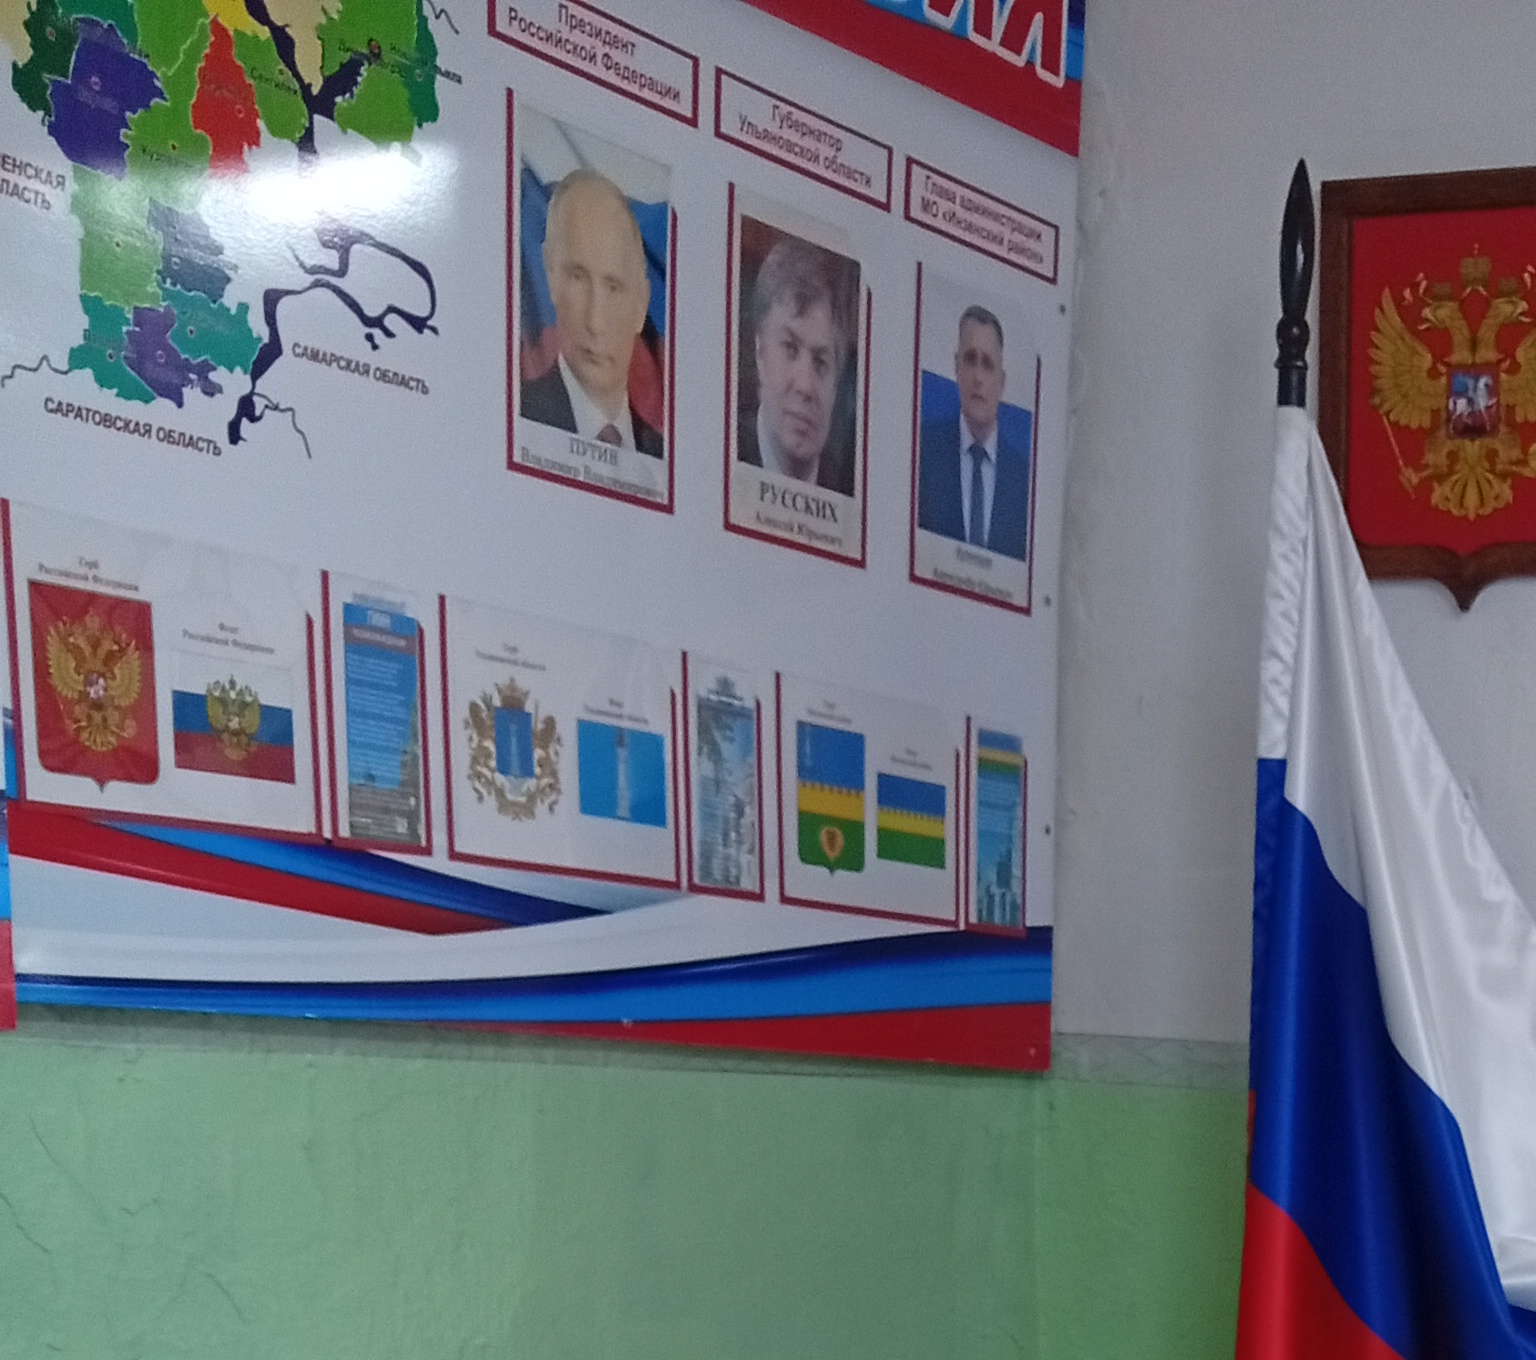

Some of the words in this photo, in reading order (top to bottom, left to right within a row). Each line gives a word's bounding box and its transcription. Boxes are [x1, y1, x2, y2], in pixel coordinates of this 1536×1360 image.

[558, 3, 636, 56] Президент
[508, 6, 598, 66] Российской
[601, 51, 681, 104] Федерации
[738, 112, 820, 168] Ульяновской
[823, 156, 872, 190] области
[771, 104, 843, 152] Губернатор
[921, 196, 939, 218] МО
[925, 175, 957, 204] Глава
[292, 342, 371, 377] САМАРСКАЯ
[373, 366, 429, 395] ОБЛАСТЬ
[44, 397, 152, 440] САРАТОВСКАЯ
[156, 426, 222, 457] ОБЛАСТЬ
[570, 437, 618, 466] ПУТИН
[759, 481, 838, 524] РУССКИХ
